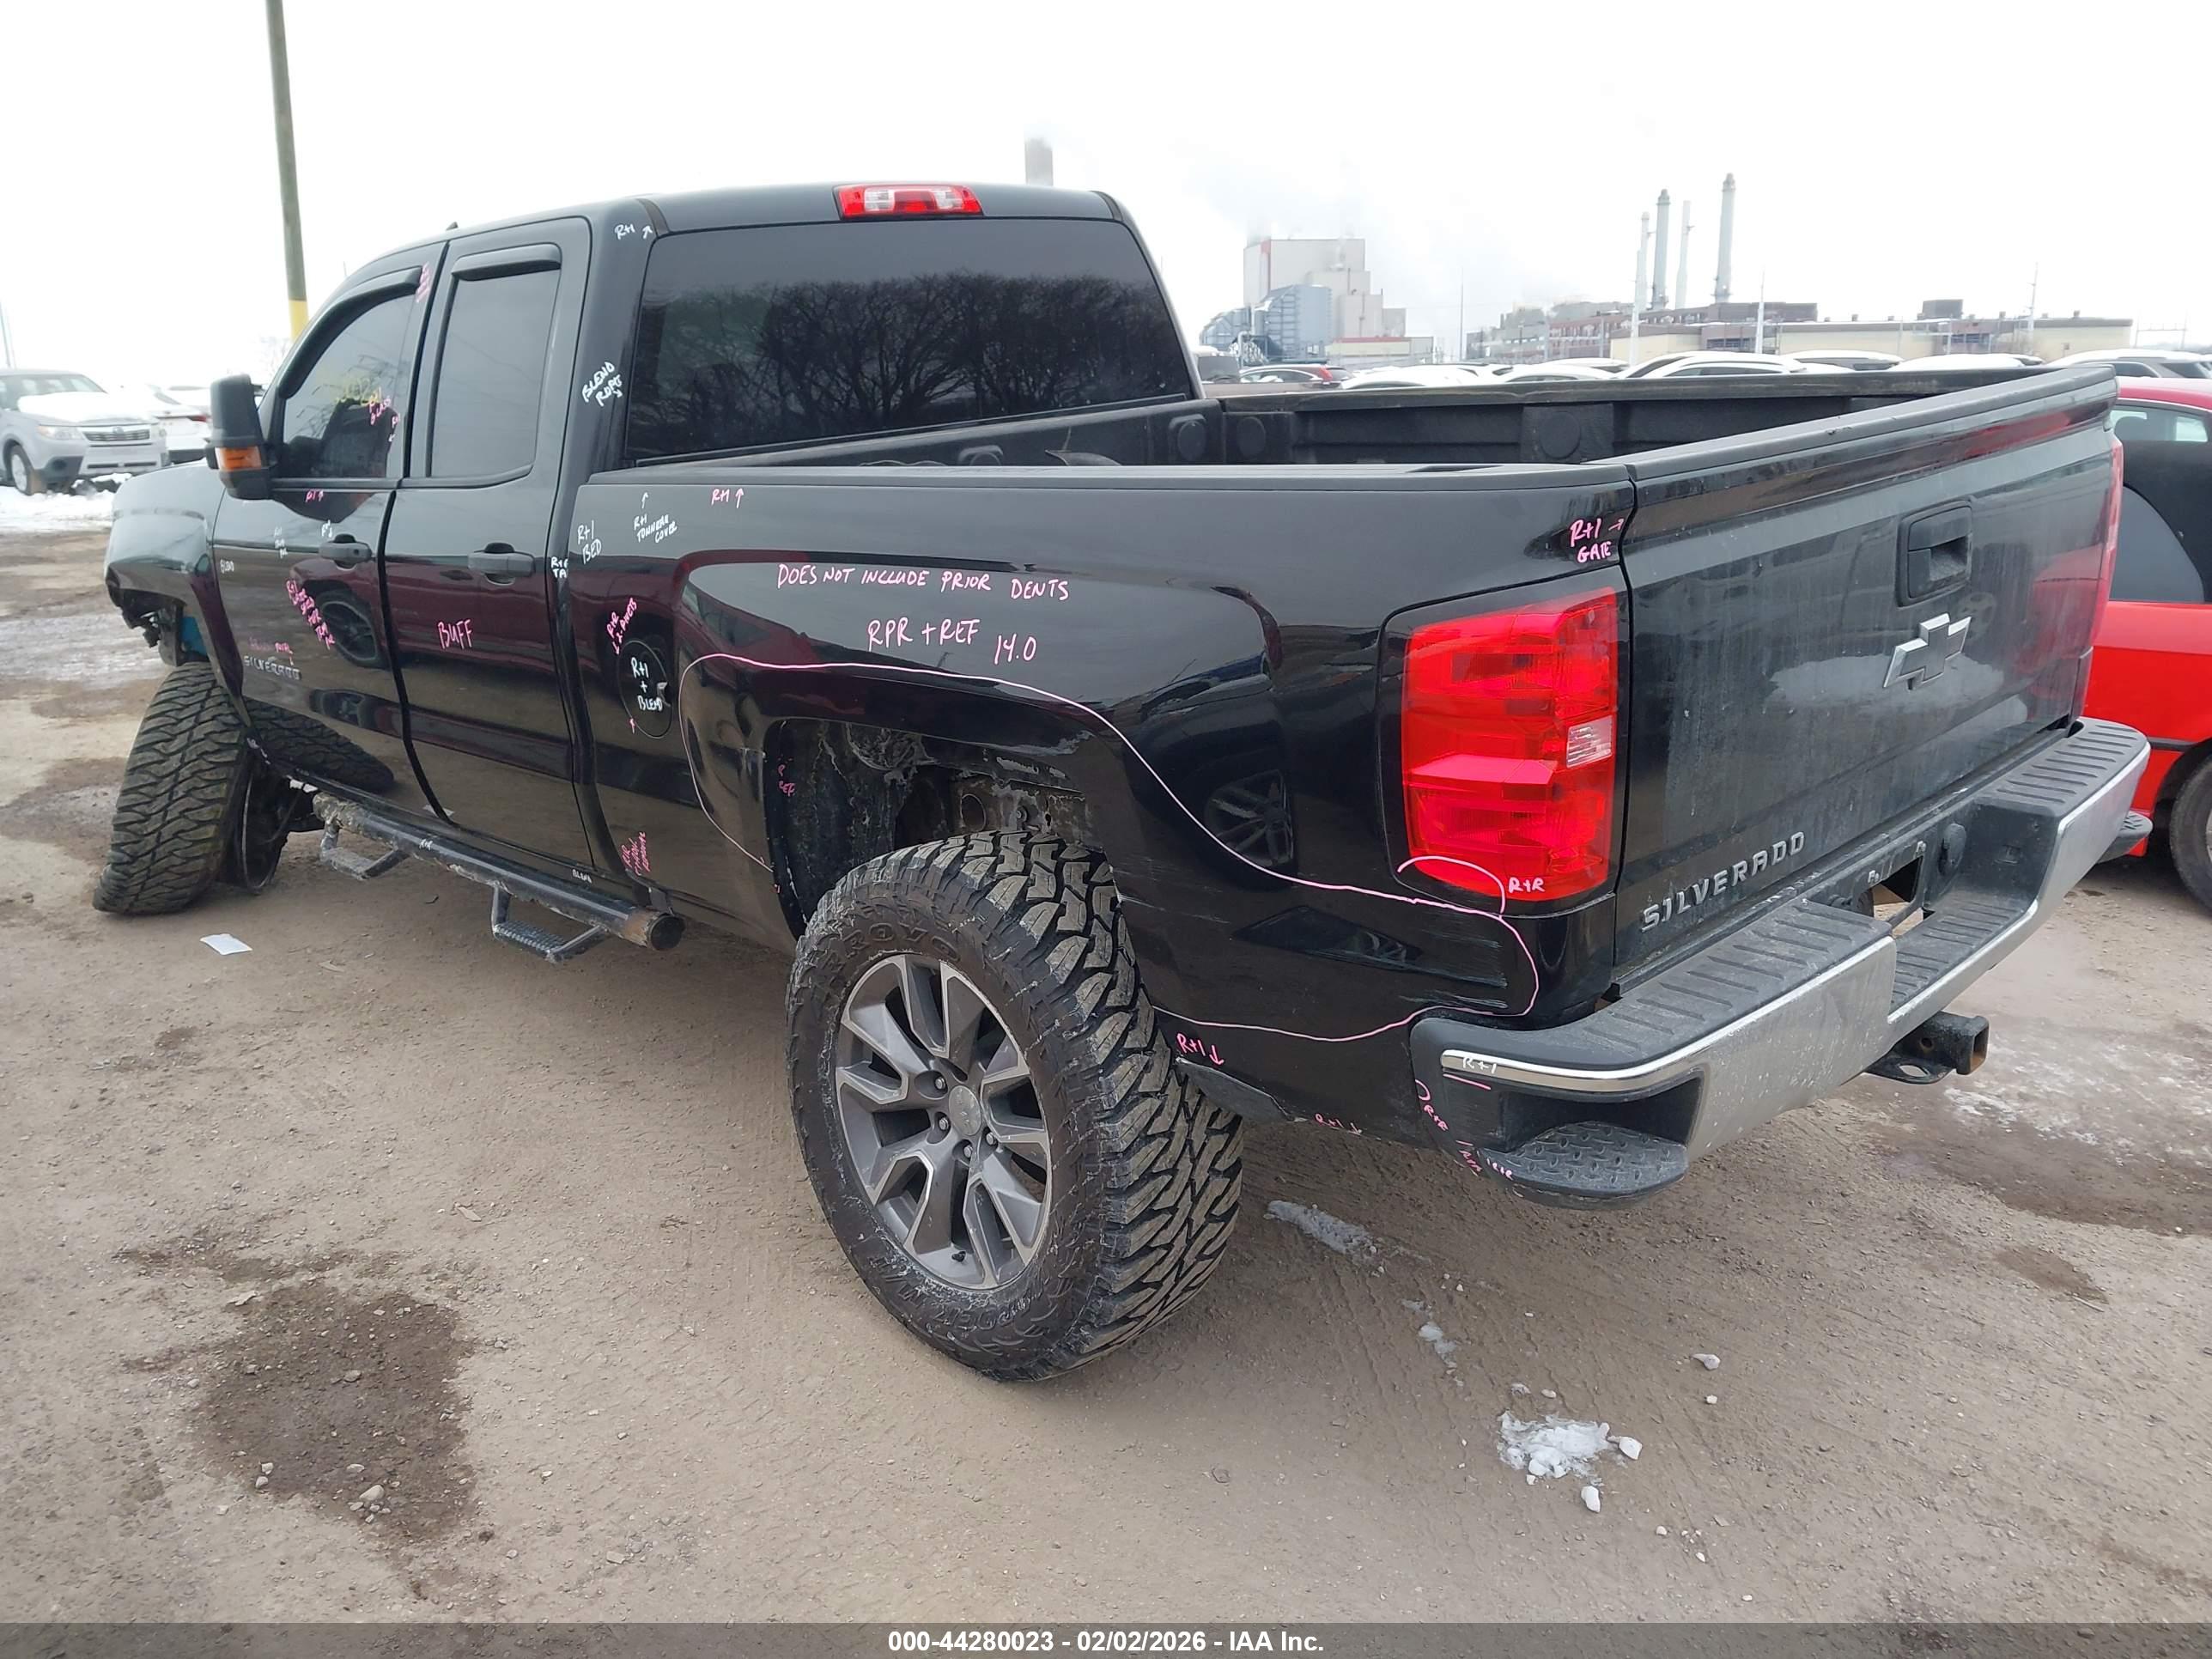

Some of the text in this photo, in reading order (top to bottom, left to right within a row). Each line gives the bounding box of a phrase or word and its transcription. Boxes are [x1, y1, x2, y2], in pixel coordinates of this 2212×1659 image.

[582, 538, 602, 564] BED
[777, 563, 1070, 600] DOES NOT INCLUDE PRIOR DENTS
[438, 619, 472, 649] BUFF
[867, 617, 913, 652] RPR
[243, 653, 303, 681] SILVERADO
[1640, 831, 1805, 933] SILVERADO
